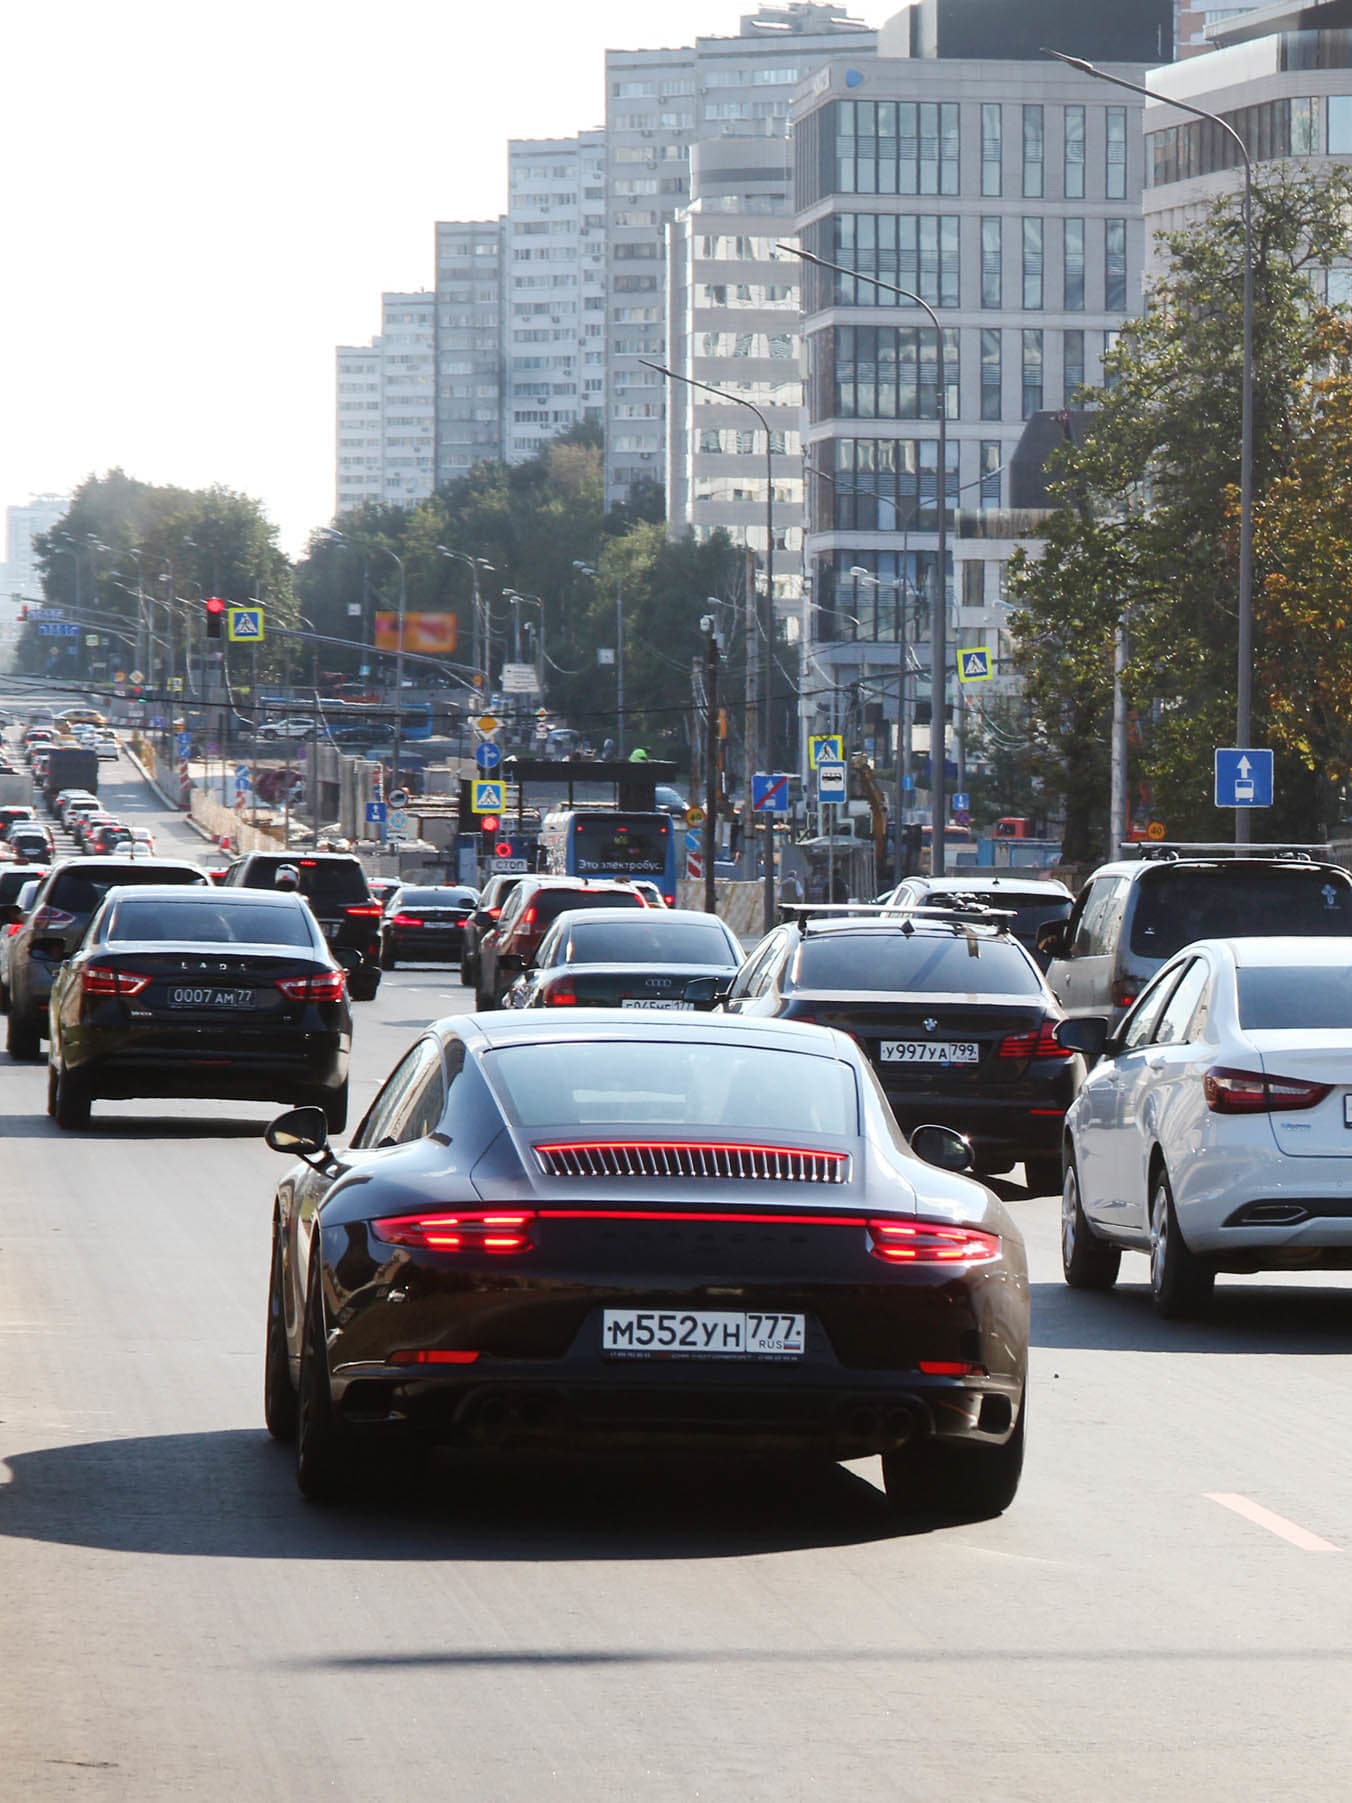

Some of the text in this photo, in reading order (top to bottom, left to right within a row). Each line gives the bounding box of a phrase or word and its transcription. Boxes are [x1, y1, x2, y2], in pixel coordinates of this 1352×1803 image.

[495, 860, 525, 870] СТОП
[578, 859, 599, 869] Это
[238, 990, 252, 1001] 77
[951, 1044, 974, 1056] 799
[748, 1315, 796, 1339] 777
[759, 1339, 783, 1350] RUS
